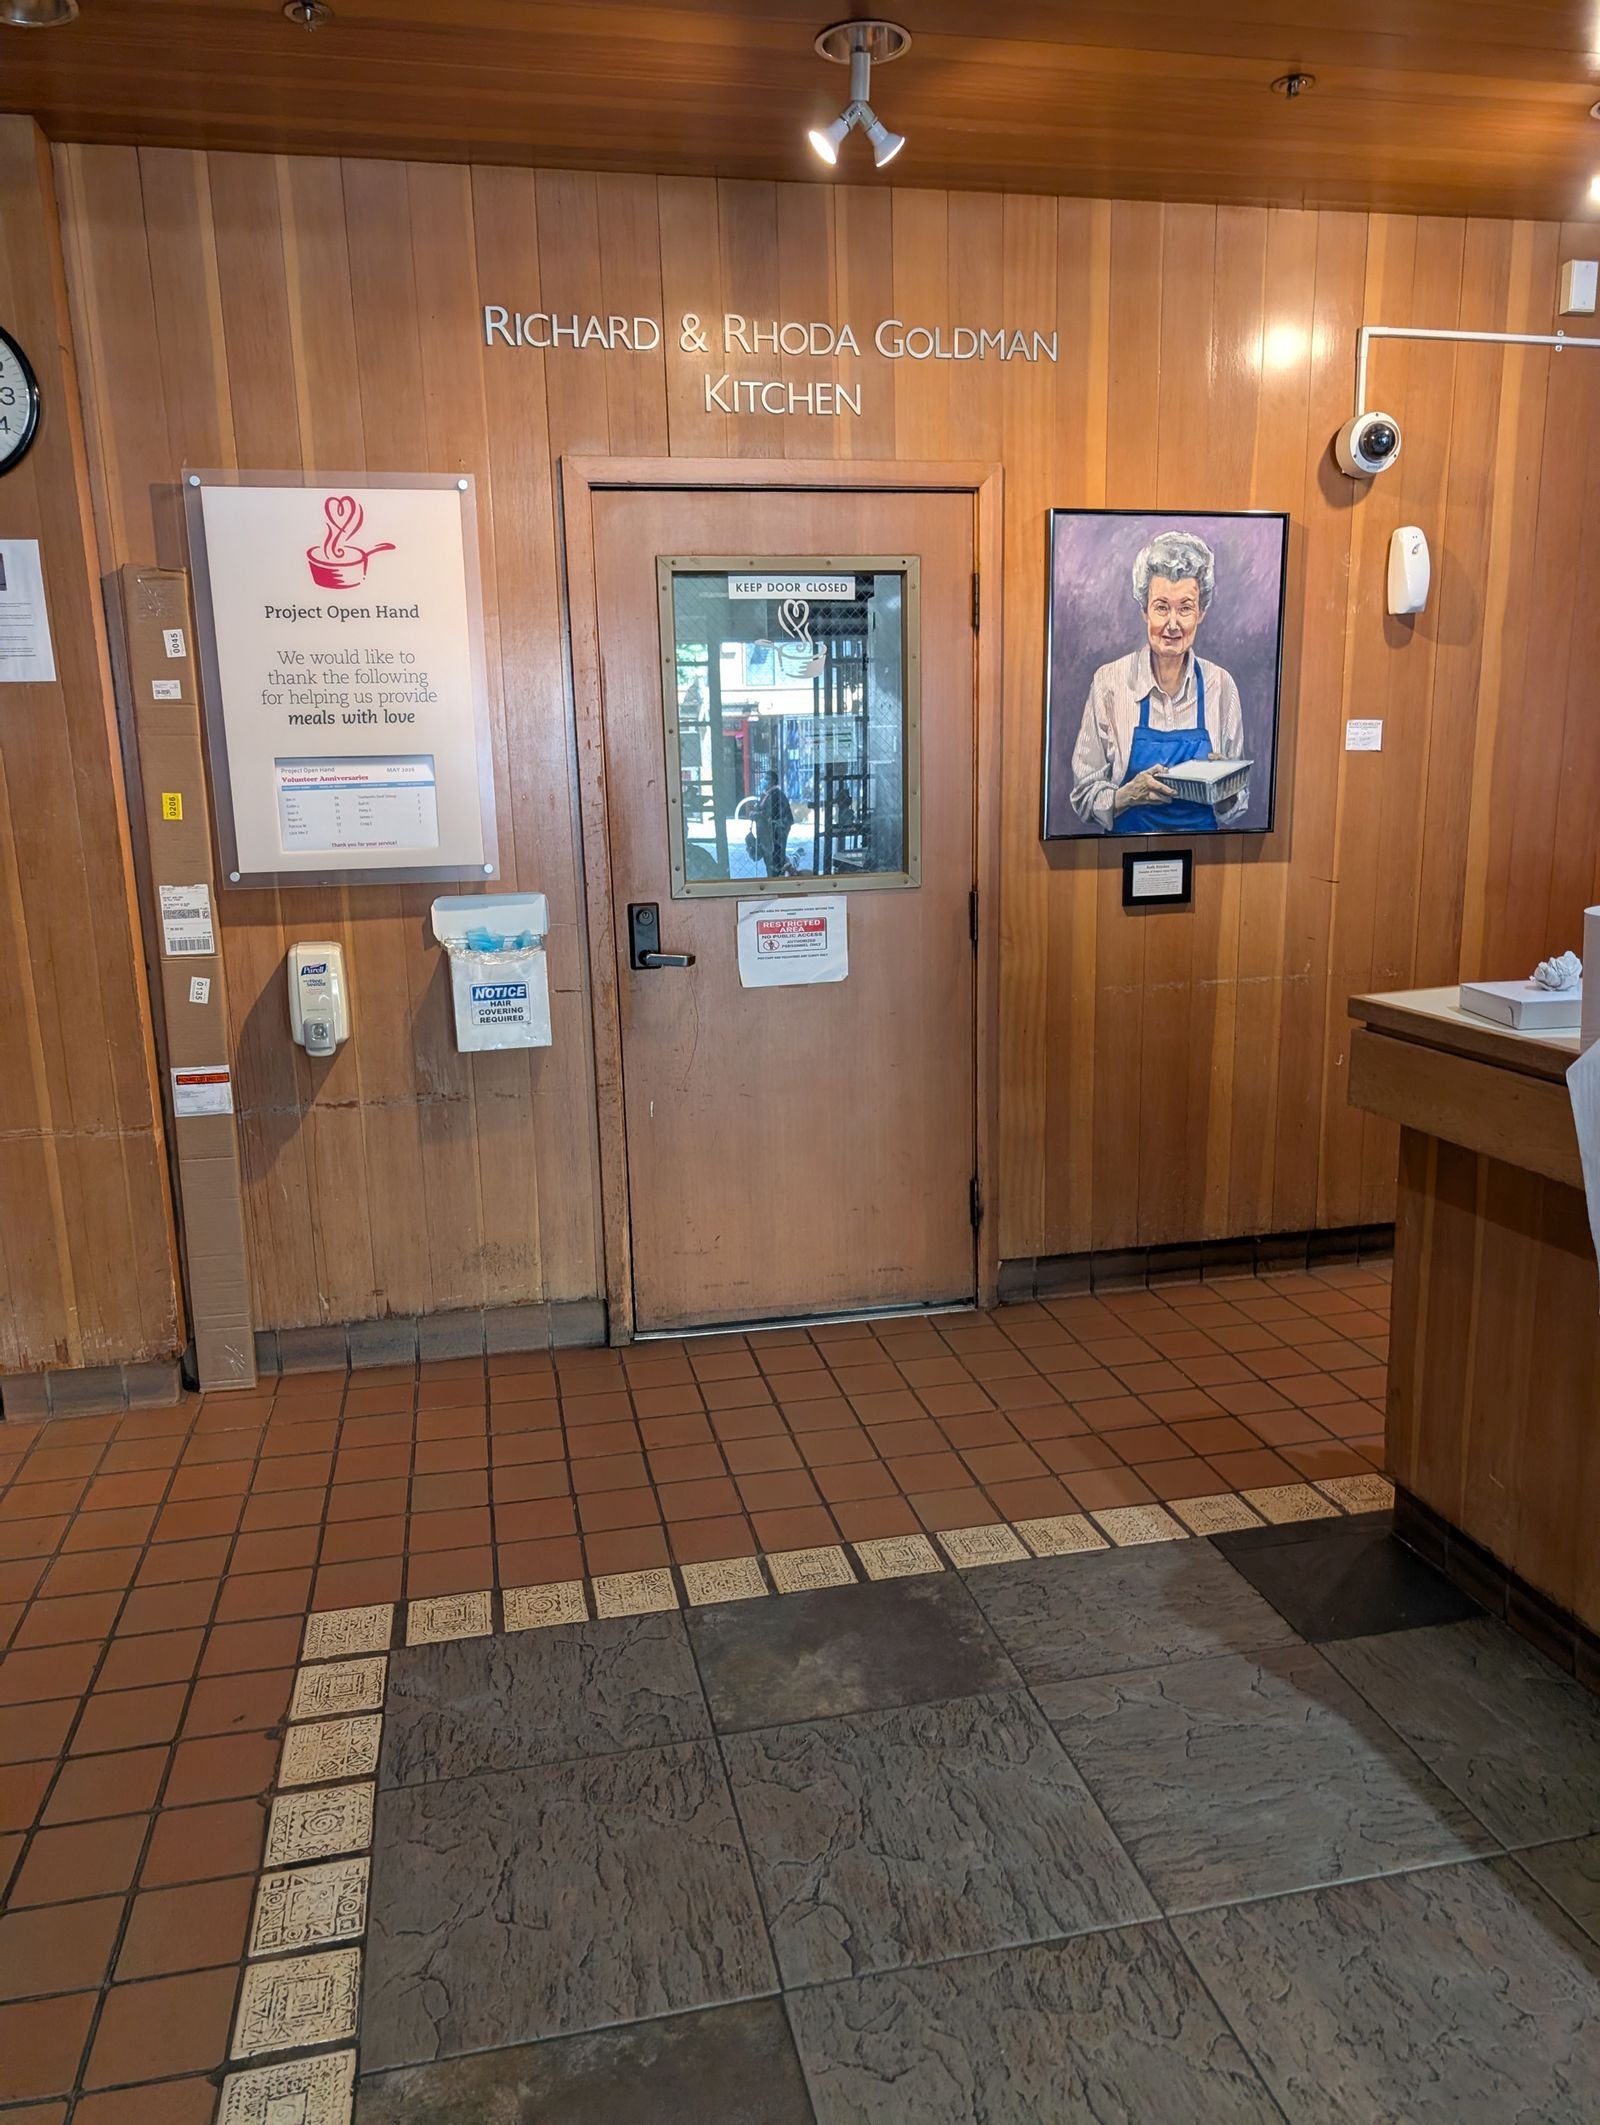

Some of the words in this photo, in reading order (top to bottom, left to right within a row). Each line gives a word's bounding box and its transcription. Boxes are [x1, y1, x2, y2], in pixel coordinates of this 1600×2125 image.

[679, 313, 709, 352] &
[0, 387, 15, 406] 3
[736, 583, 762, 592] KEEP
[767, 583, 801, 592] DOOR
[806, 583, 848, 592] CLOSED
[264, 604, 322, 623] Project
[327, 605, 371, 622] Open
[376, 604, 420, 619] Hand
[171, 633, 180, 653] 0045
[277, 650, 305, 665] We
[310, 649, 360, 665] would
[365, 649, 394, 664] like
[399, 650, 415, 664] to
[268, 669, 317, 685] thank
[323, 669, 350, 685] the
[355, 668, 429, 687] following
[261, 689, 284, 705] for
[288, 689, 350, 708] helping
[354, 691, 373, 704] us
[377, 688, 438, 707] provide
[288, 710, 336, 725] meals
[342, 709, 378, 724] with
[384, 709, 415, 724] love
[280, 767, 303, 775] Project
[169, 796, 177, 817] 0206
[763, 919, 821, 928] RESTRICTED
[195, 981, 204, 1001] 0135
[475, 986, 525, 999] NOTICE
[479, 1006, 524, 1015] COVERING
[480, 1015, 524, 1023] REQUIRED
